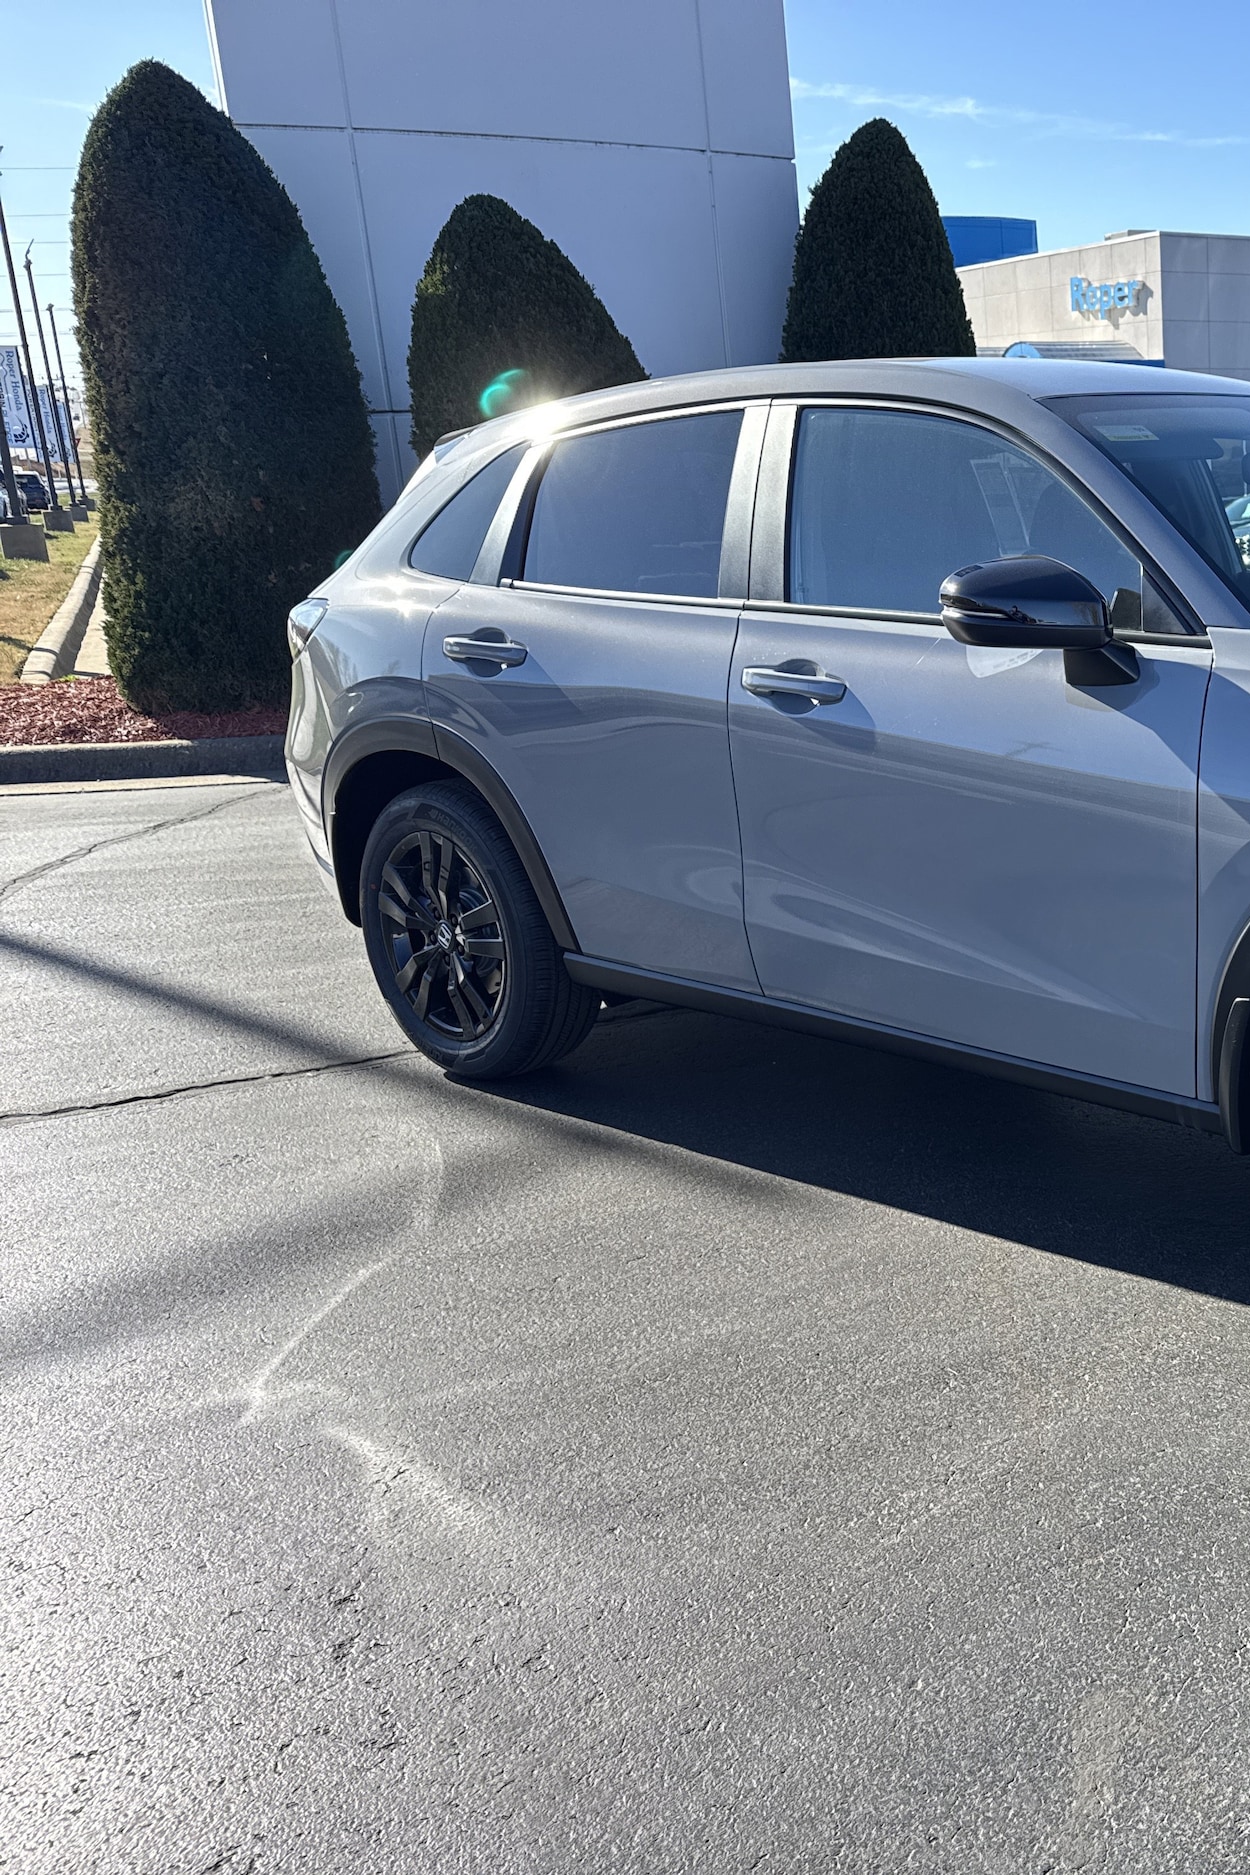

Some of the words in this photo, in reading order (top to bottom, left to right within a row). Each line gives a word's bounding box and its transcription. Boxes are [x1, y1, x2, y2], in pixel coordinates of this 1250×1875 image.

[1070, 276, 1140, 320] Roper
[5, 350, 17, 381] Roper
[11, 381, 23, 412] Honda
